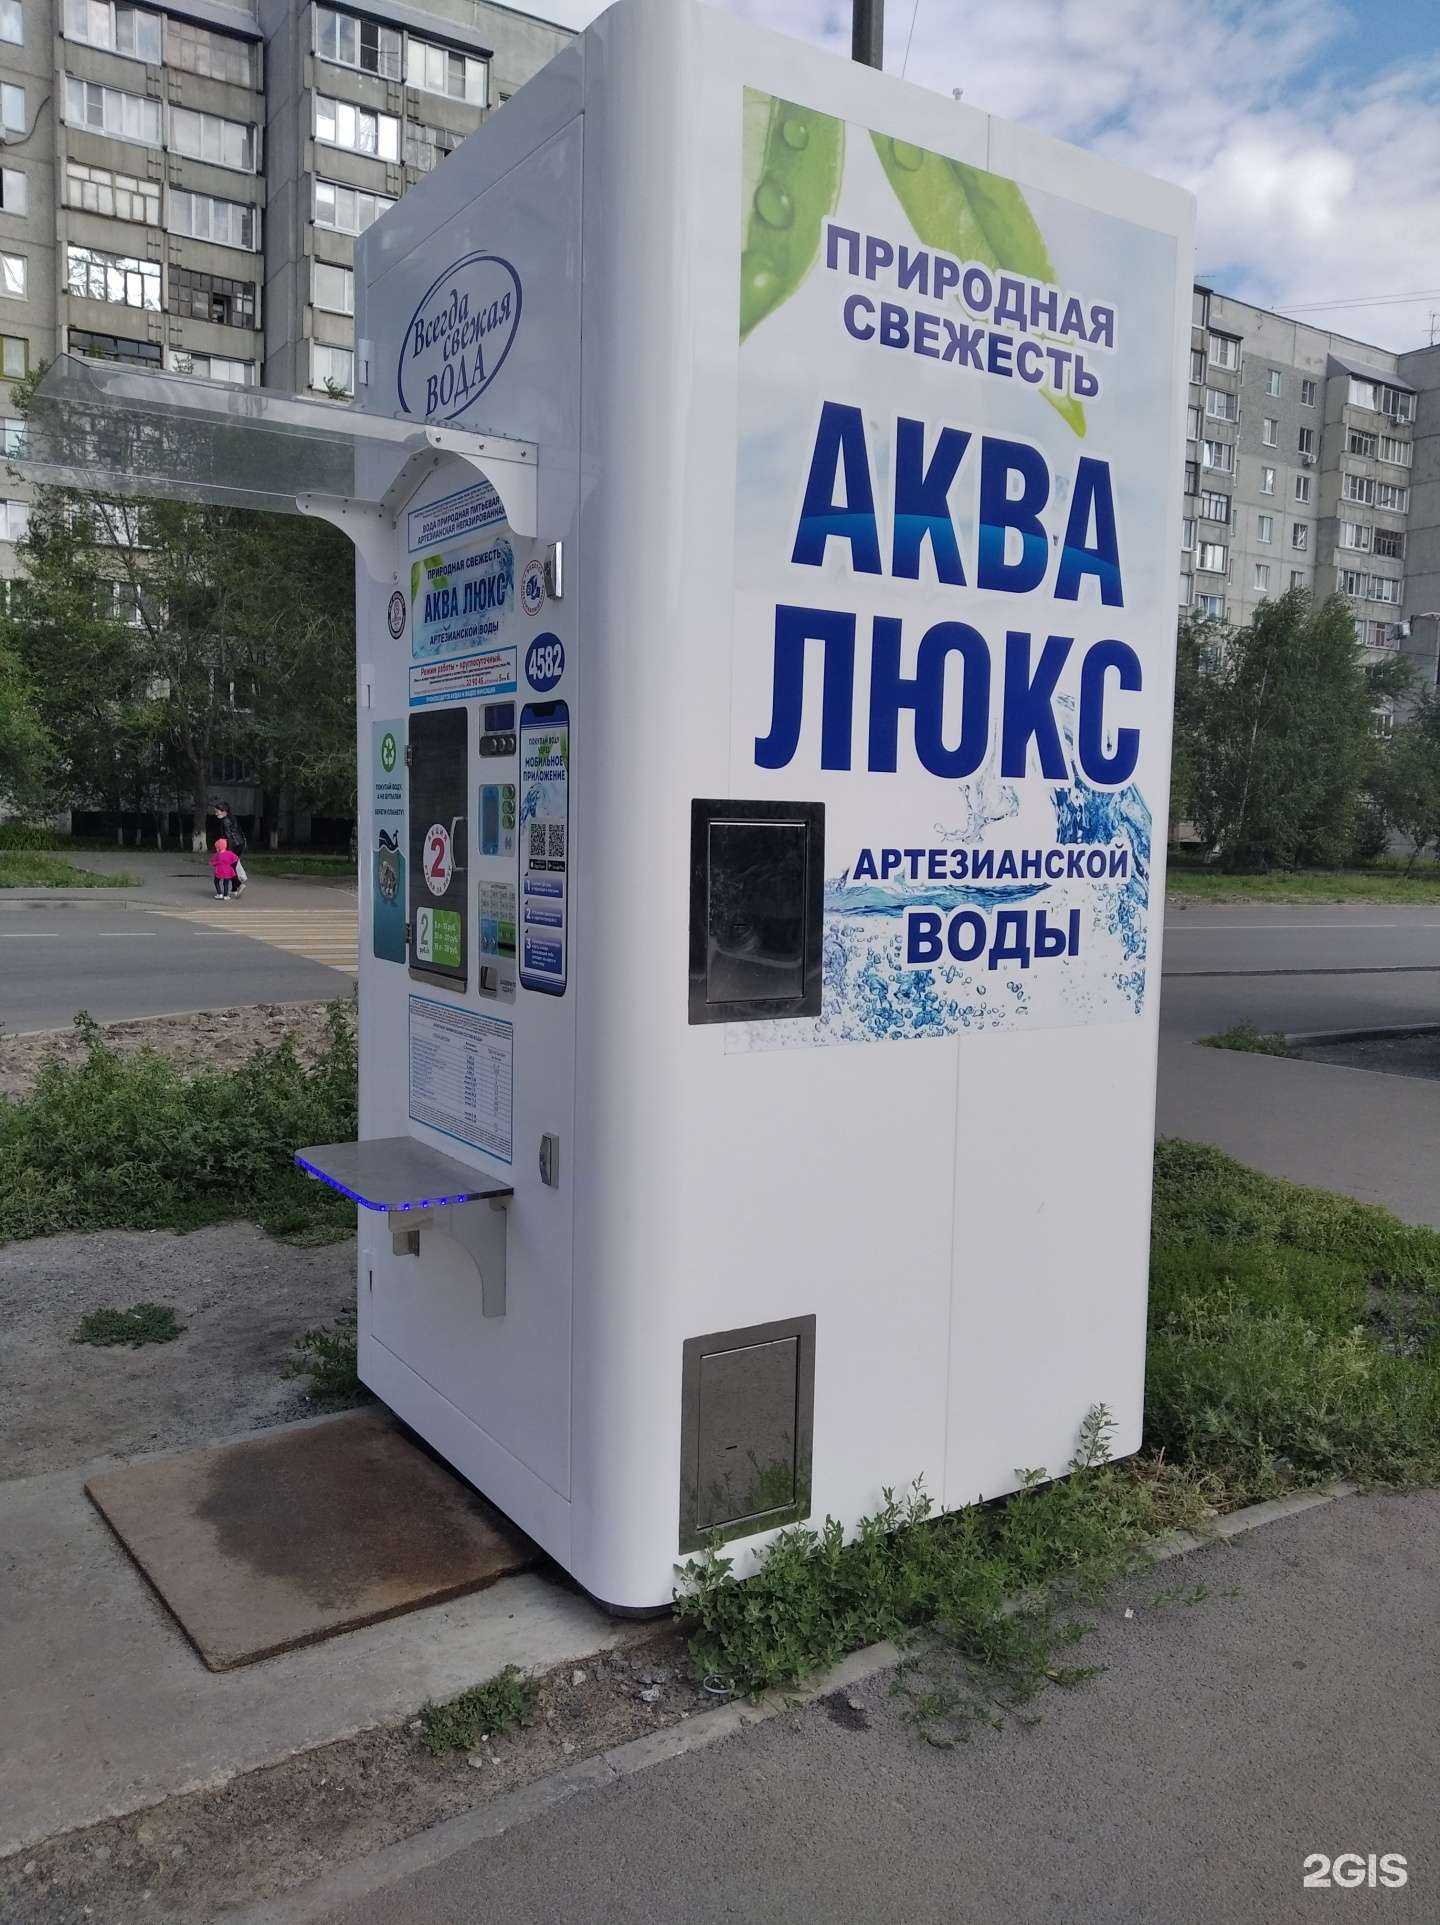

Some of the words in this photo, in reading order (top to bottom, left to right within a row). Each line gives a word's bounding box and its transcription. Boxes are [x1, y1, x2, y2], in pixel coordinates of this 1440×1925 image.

[826, 223, 1115, 348] ПРИРОДНАЯ
[412, 288, 469, 359] Всегда
[443, 292, 511, 362] свежая
[843, 295, 1100, 398] СВЕЖЕСТЬ
[426, 343, 487, 416] ВОДА
[437, 508, 470, 529] ПРИРОДНАЯ
[470, 495, 500, 516] ПИТЬЕВАЯ
[791, 400, 1125, 608] АКВА
[417, 523, 456, 545] АРТЕЗИАНСКАЯ
[456, 505, 505, 531] НЕГАЗИРОВАННА
[427, 561, 465, 580] ПРИРОДНАЯ
[465, 548, 501, 569] СВЕЖЕСТЬ
[424, 586, 459, 624] АКВА
[463, 572, 506, 615] ЛЮКС
[429, 625, 478, 645] АРТЕЗИАНСКОЙ
[479, 621, 499, 637] ВОДЫ
[528, 644, 564, 680] 4582
[754, 604, 1144, 786] ЛЮКС
[523, 770, 566, 782] ПРИЛОЖЕНИЕ
[525, 755, 564, 768] МОБИЛЬНОЕ
[430, 837, 446, 878] 2
[853, 843, 1129, 880] АРТЕЗИАНСКОЙ
[421, 912, 429, 945] 2
[907, 908, 1081, 971] ВОДЫ
